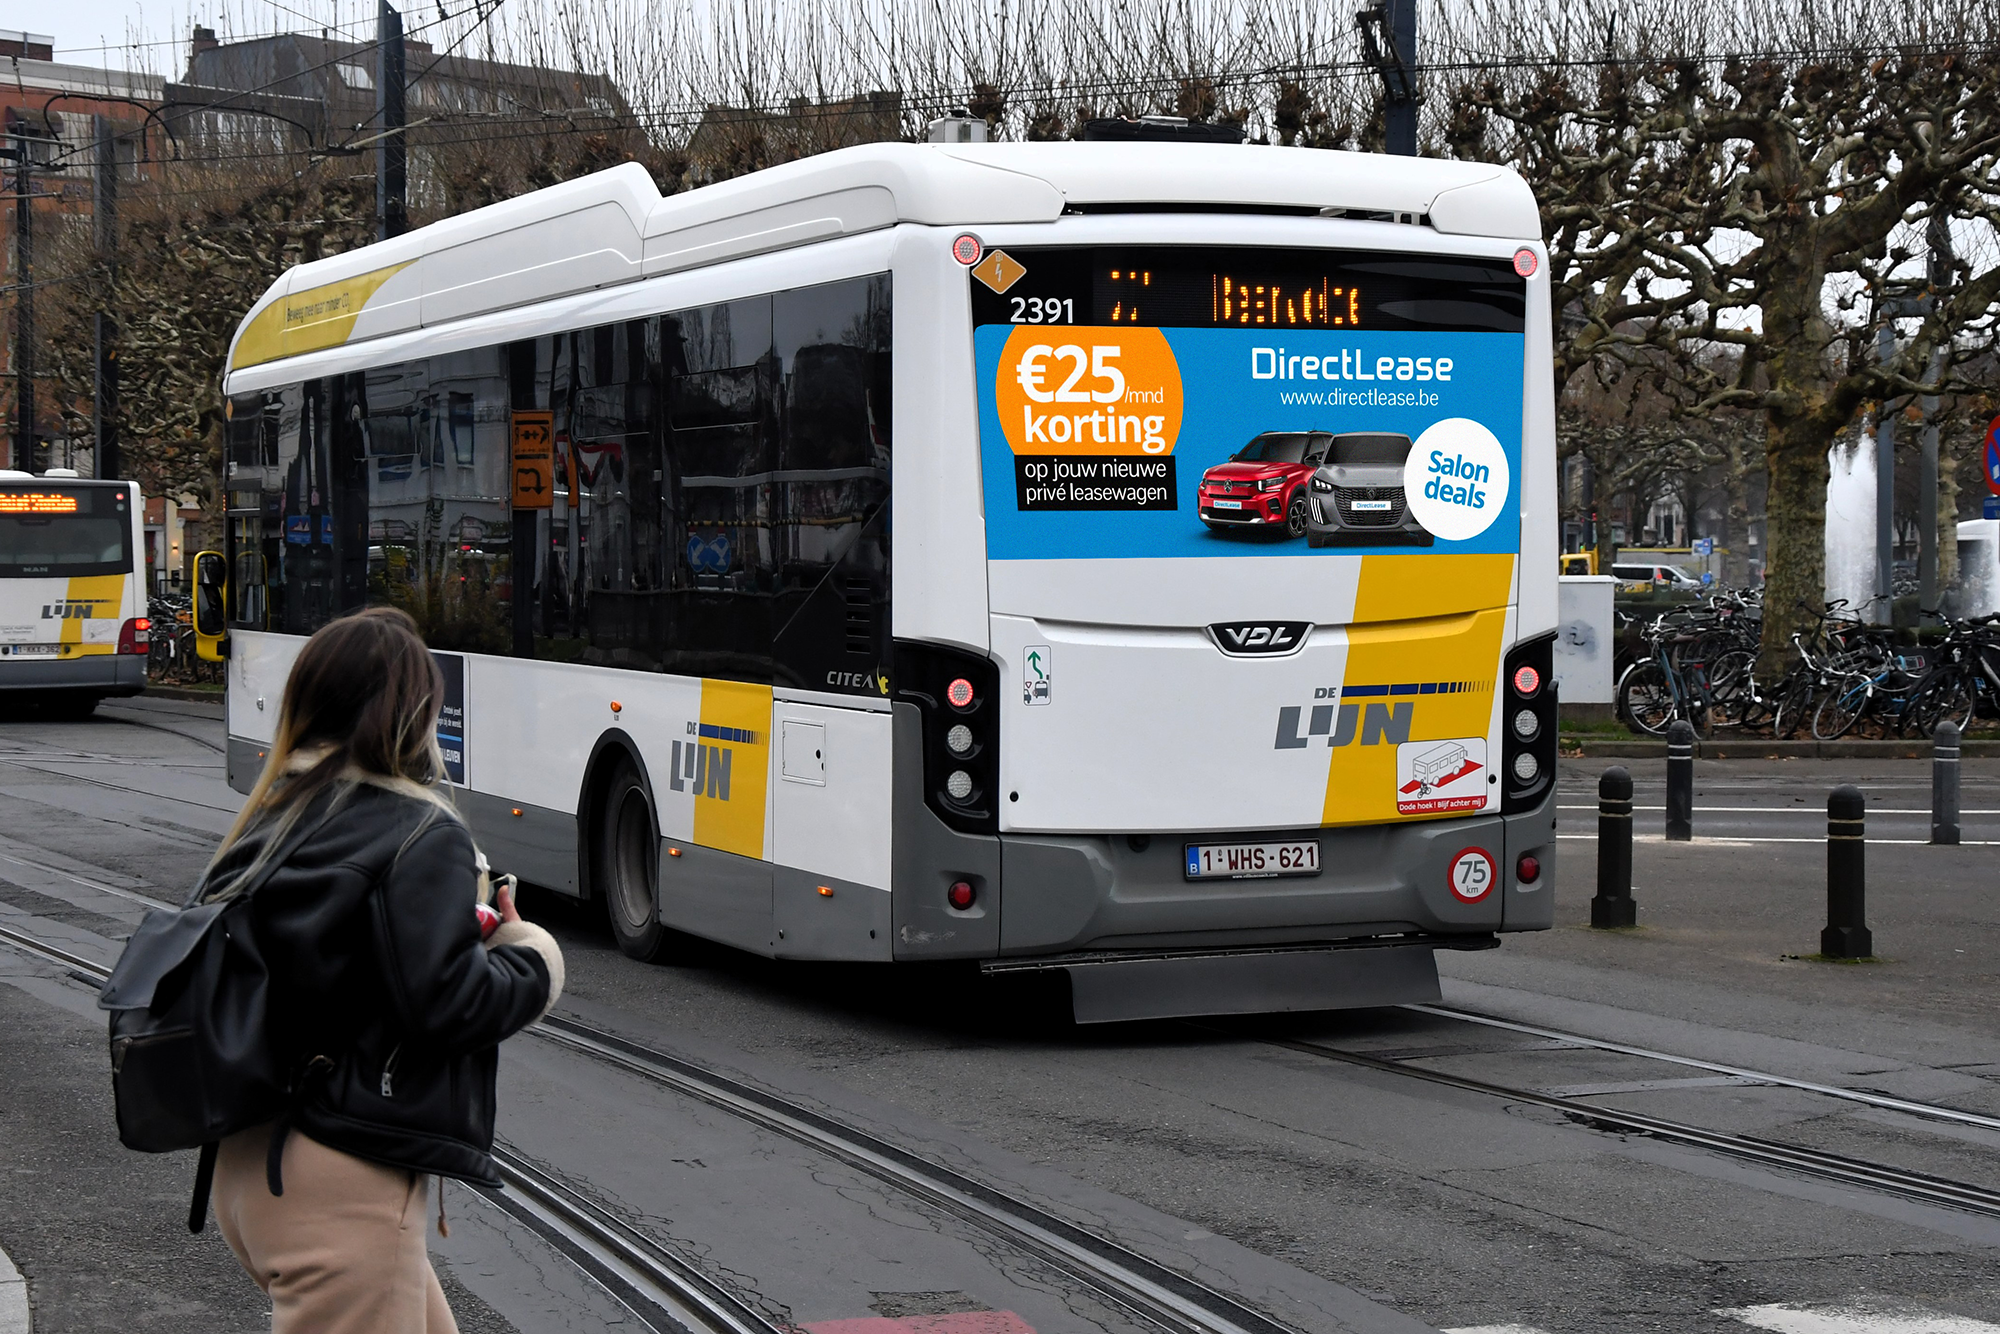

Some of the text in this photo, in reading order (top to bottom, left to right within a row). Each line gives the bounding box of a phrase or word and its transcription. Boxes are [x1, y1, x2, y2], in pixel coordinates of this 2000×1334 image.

[1010, 297, 1073, 324] 2391
[1016, 344, 1125, 403] €25
[1252, 347, 1454, 381] DirectLease
[1280, 388, 1439, 406] www.directlease.be
[1024, 405, 1166, 454] korting
[1024, 458, 1167, 482] op jouw nieuwe
[1428, 450, 1490, 483] Salon
[1026, 483, 1167, 505] privé leasewagen
[1424, 476, 1486, 509] deals
[41, 605, 93, 619] LIJN
[1225, 627, 1293, 646] VDL
[827, 671, 874, 689] CITEA
[1314, 687, 1337, 699] DE
[686, 721, 697, 735] DE
[1274, 702, 1414, 749] LIJN
[670, 740, 732, 802] LIJN
[1400, 803, 1416, 811] Dode
[1437, 800, 1450, 809] Blijf
[1450, 799, 1470, 807] achter
[1471, 798, 1481, 806] mij
[1190, 863, 1198, 873] B
[1203, 846, 1315, 871] 1-WHS-621
[1460, 860, 1486, 884] 75
[1466, 885, 1478, 893] km
